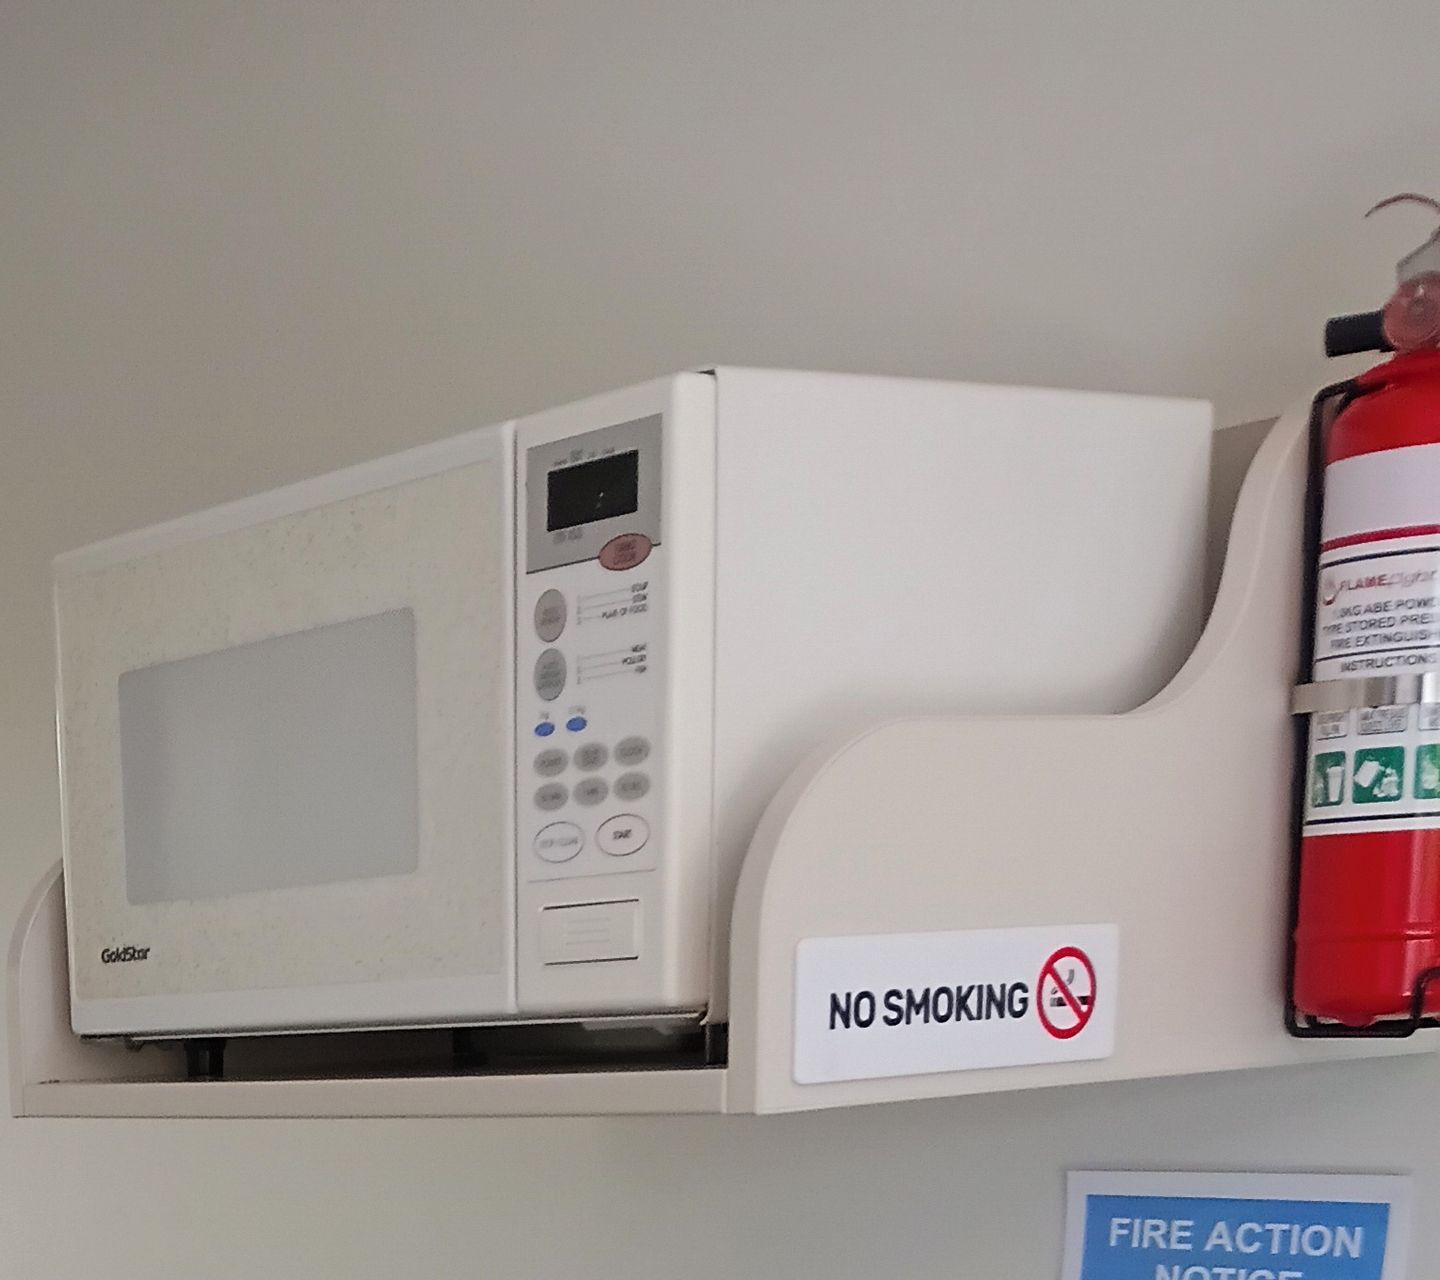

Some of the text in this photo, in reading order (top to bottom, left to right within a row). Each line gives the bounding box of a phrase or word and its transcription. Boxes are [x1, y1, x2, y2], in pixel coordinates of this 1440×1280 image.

[1363, 600, 1393, 614] ABE
[1345, 615, 1396, 633] STORED
[829, 982, 1029, 1029] NO SMOKING
[1109, 1217, 1364, 1259] FIRE ACTION
